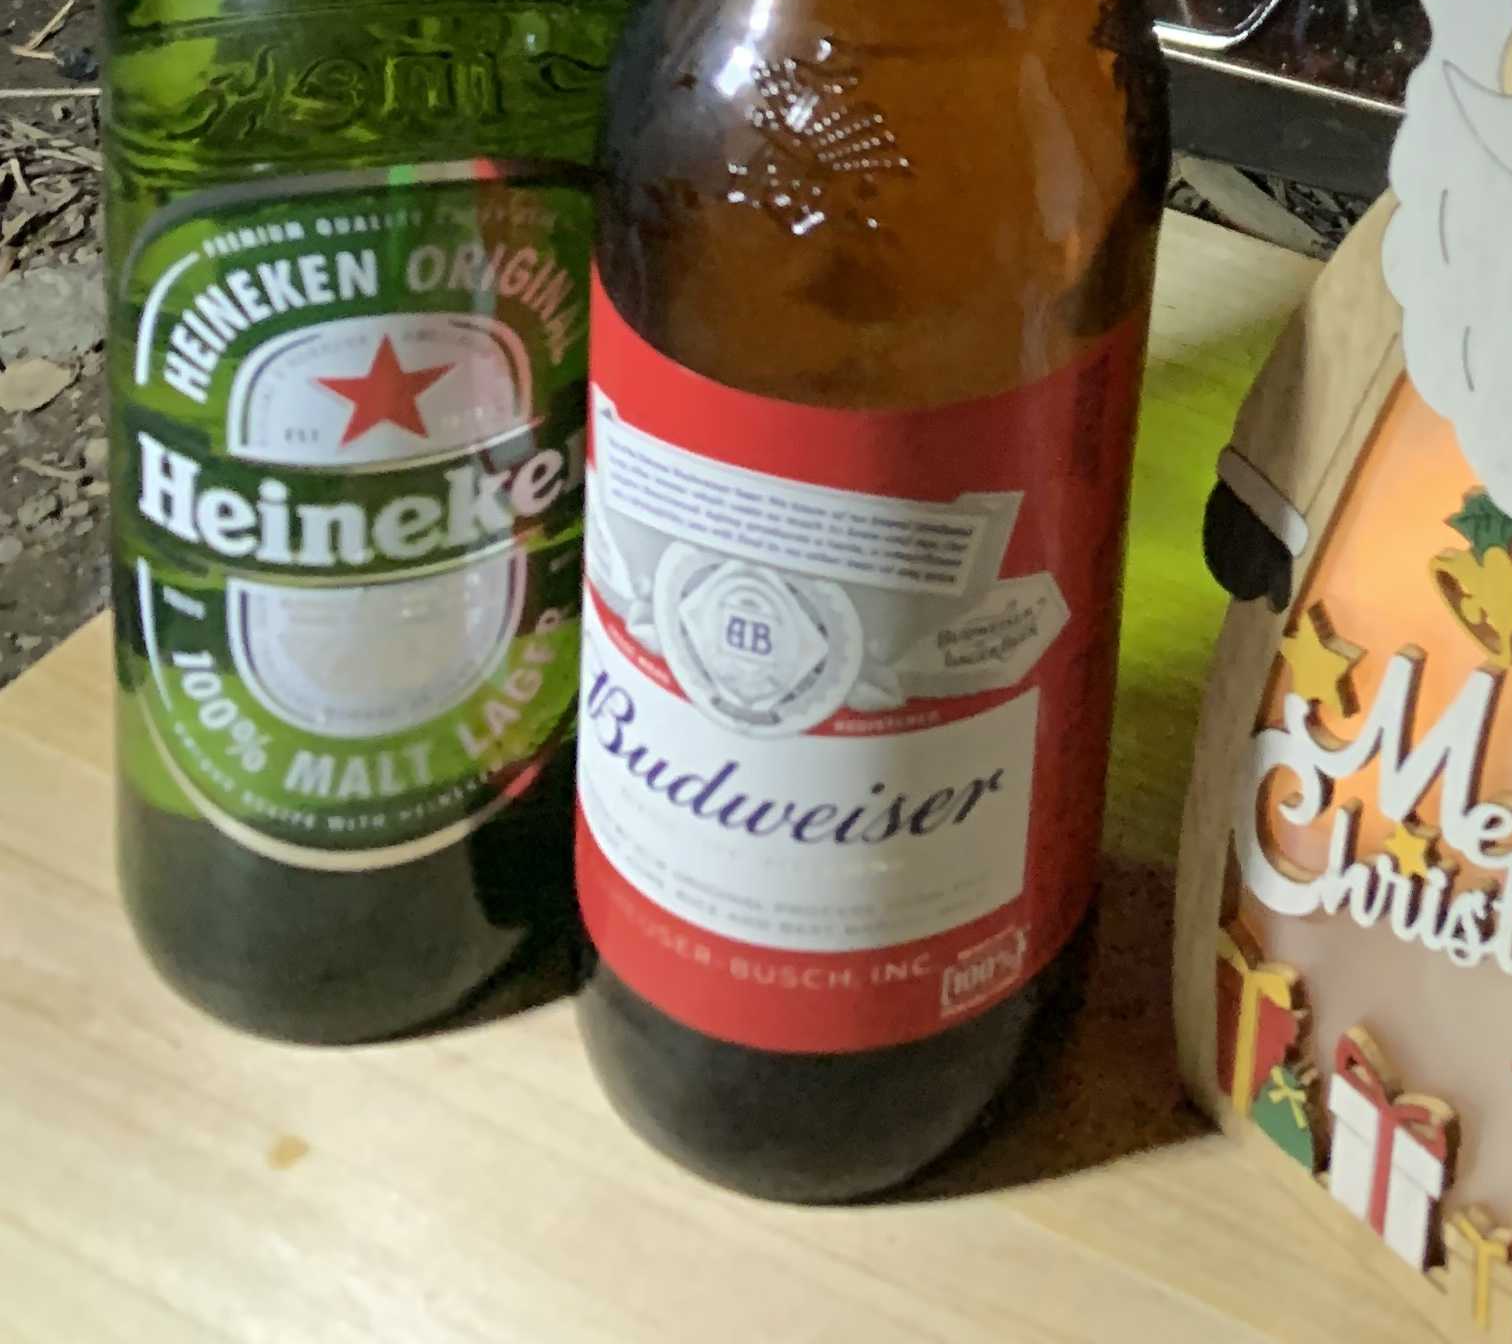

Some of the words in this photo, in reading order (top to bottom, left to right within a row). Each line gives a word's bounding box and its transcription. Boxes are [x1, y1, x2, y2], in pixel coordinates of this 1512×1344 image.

[163, 249, 380, 405] HEINEKEN
[172, 650, 273, 774] 100%
[283, 738, 434, 801] MALT
[456, 604, 572, 760] LAGER
[585, 669, 1005, 845] Budweiser
